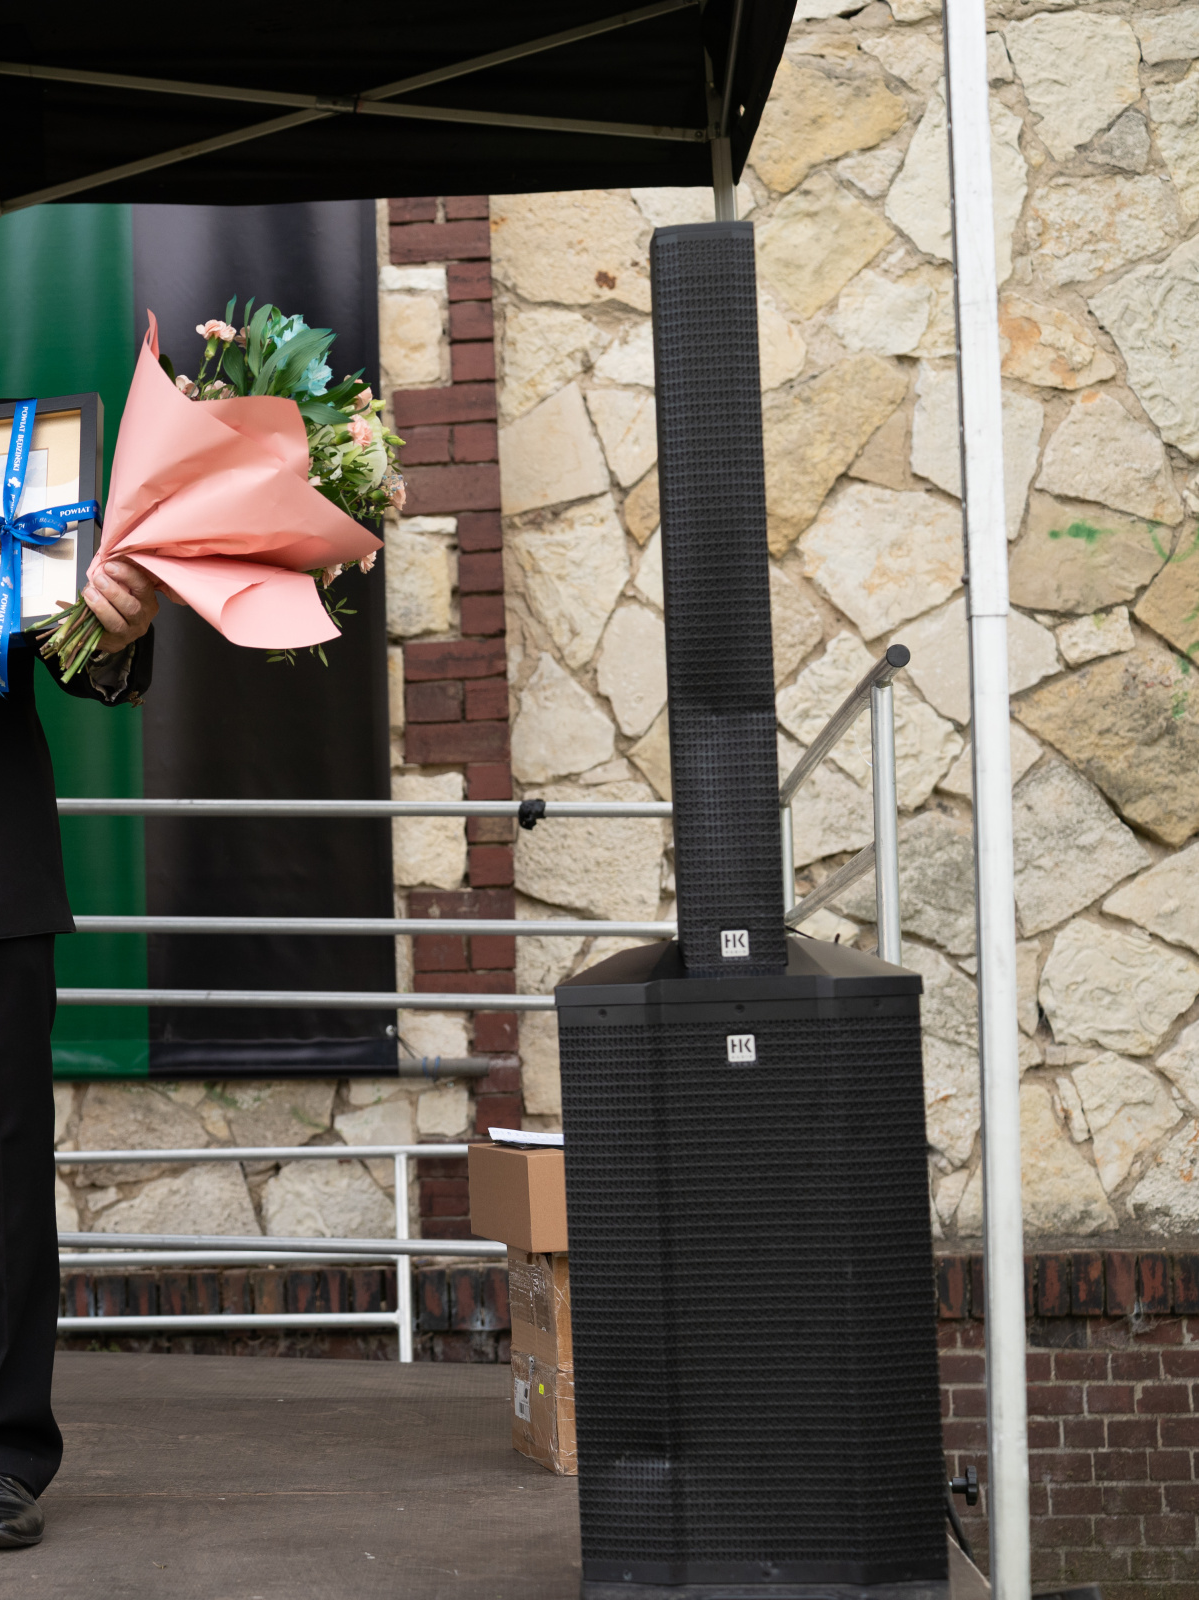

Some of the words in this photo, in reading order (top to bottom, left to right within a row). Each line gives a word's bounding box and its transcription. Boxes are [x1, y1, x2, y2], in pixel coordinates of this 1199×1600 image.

[19, 406, 29, 432] POWIAT
[13, 434, 25, 471] BĘDZIŃSKI
[59, 506, 90, 518] POWIAT
[724, 933, 746, 949] HK
[731, 1038, 752, 1053] HK
